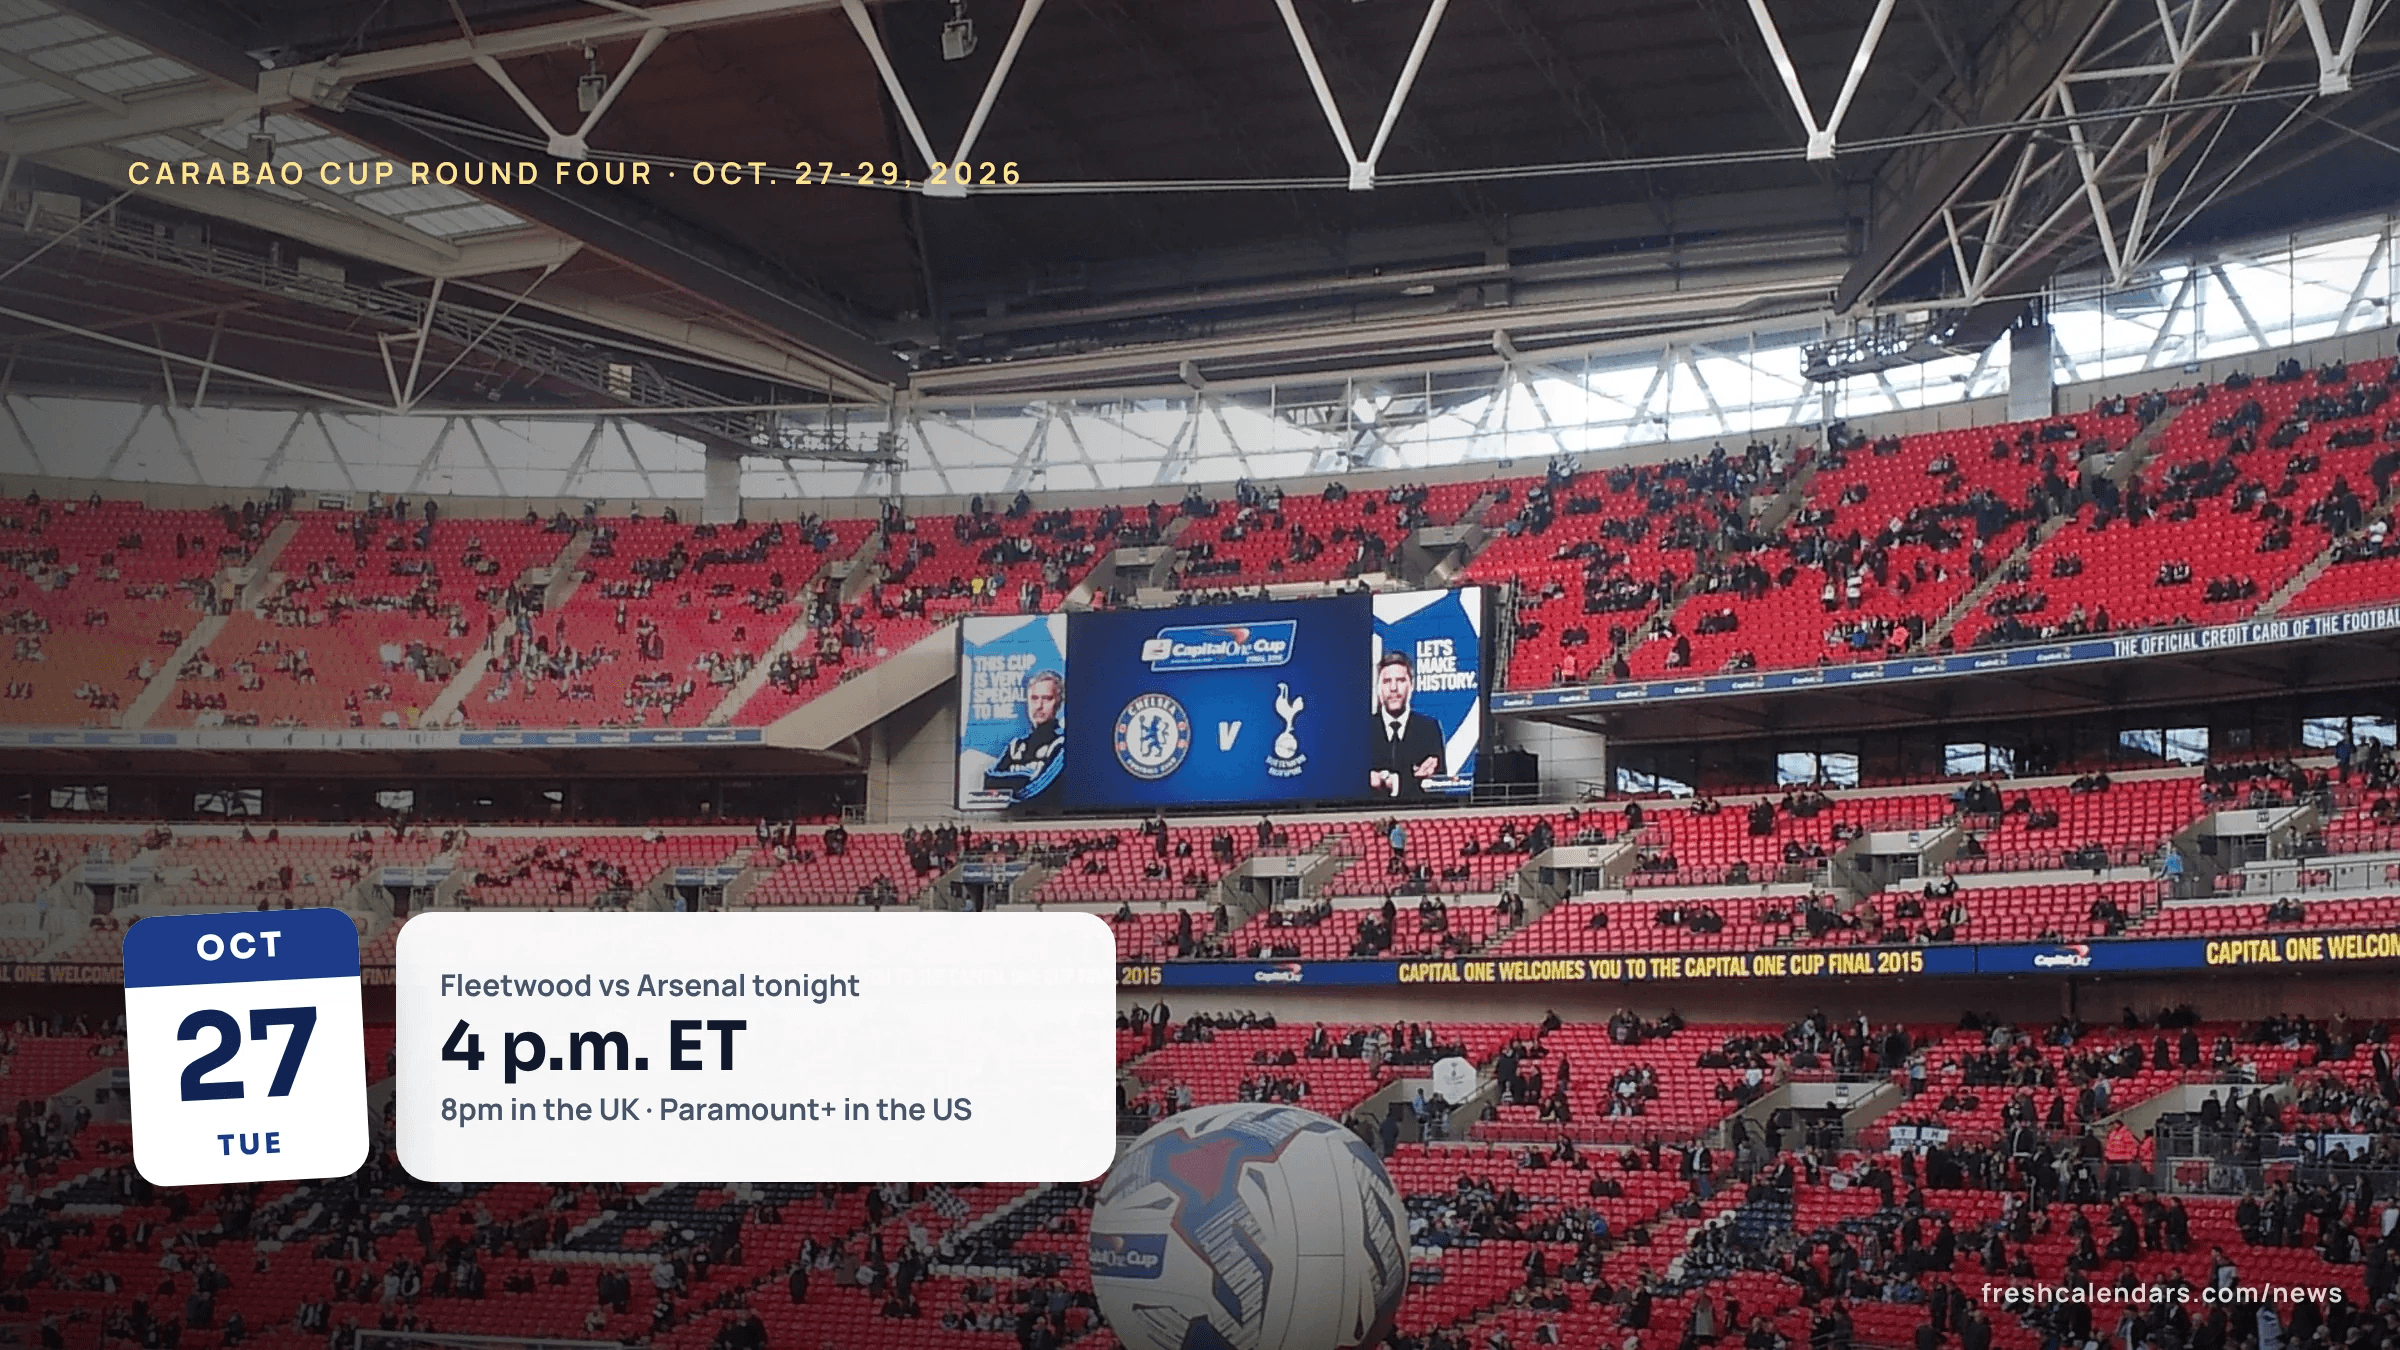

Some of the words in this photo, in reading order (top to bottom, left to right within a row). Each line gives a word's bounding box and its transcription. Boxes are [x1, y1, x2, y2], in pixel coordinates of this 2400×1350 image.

[1253, 638, 1287, 654] Cup
[2113, 638, 2138, 658] THE
[2142, 632, 2198, 655] OFFICIAL
[2202, 626, 2249, 648] CREDIT
[2252, 621, 2289, 642] CARD
[2293, 618, 2312, 638] OF
[2314, 615, 2340, 636] THE
[1416, 638, 1454, 657] LET'S
[974, 655, 1005, 672] THIS
[1007, 653, 1037, 671] CUP
[1416, 656, 1457, 675] MAKE
[974, 672, 987, 688] IS
[991, 671, 1024, 688] VERY
[1416, 672, 1478, 692] HISTORY.
[973, 687, 1027, 703] SPECIAL
[974, 704, 991, 720] TO
[1128, 696, 1177, 716] CHELSEA
[2206, 939, 2282, 965] CAPITAL
[2285, 936, 2324, 962] ONE
[14, 965, 46, 982] ONE
[1121, 966, 1162, 985] 2015
[1399, 962, 1461, 982] CAPITAL
[1463, 962, 1496, 982] ONE
[1499, 960, 1585, 981] WELCOMES
[1588, 959, 1622, 979] YOU
[1625, 958, 1647, 979] TO
[1650, 957, 1681, 978] THE
[1685, 956, 1750, 977] CAPITAL
[1753, 954, 1786, 976] ONE
[1790, 953, 1824, 975] CUP
[1828, 952, 1874, 974] FINAL
[1877, 951, 1923, 973] 2015
[1127, 1250, 1159, 1268] Cup
